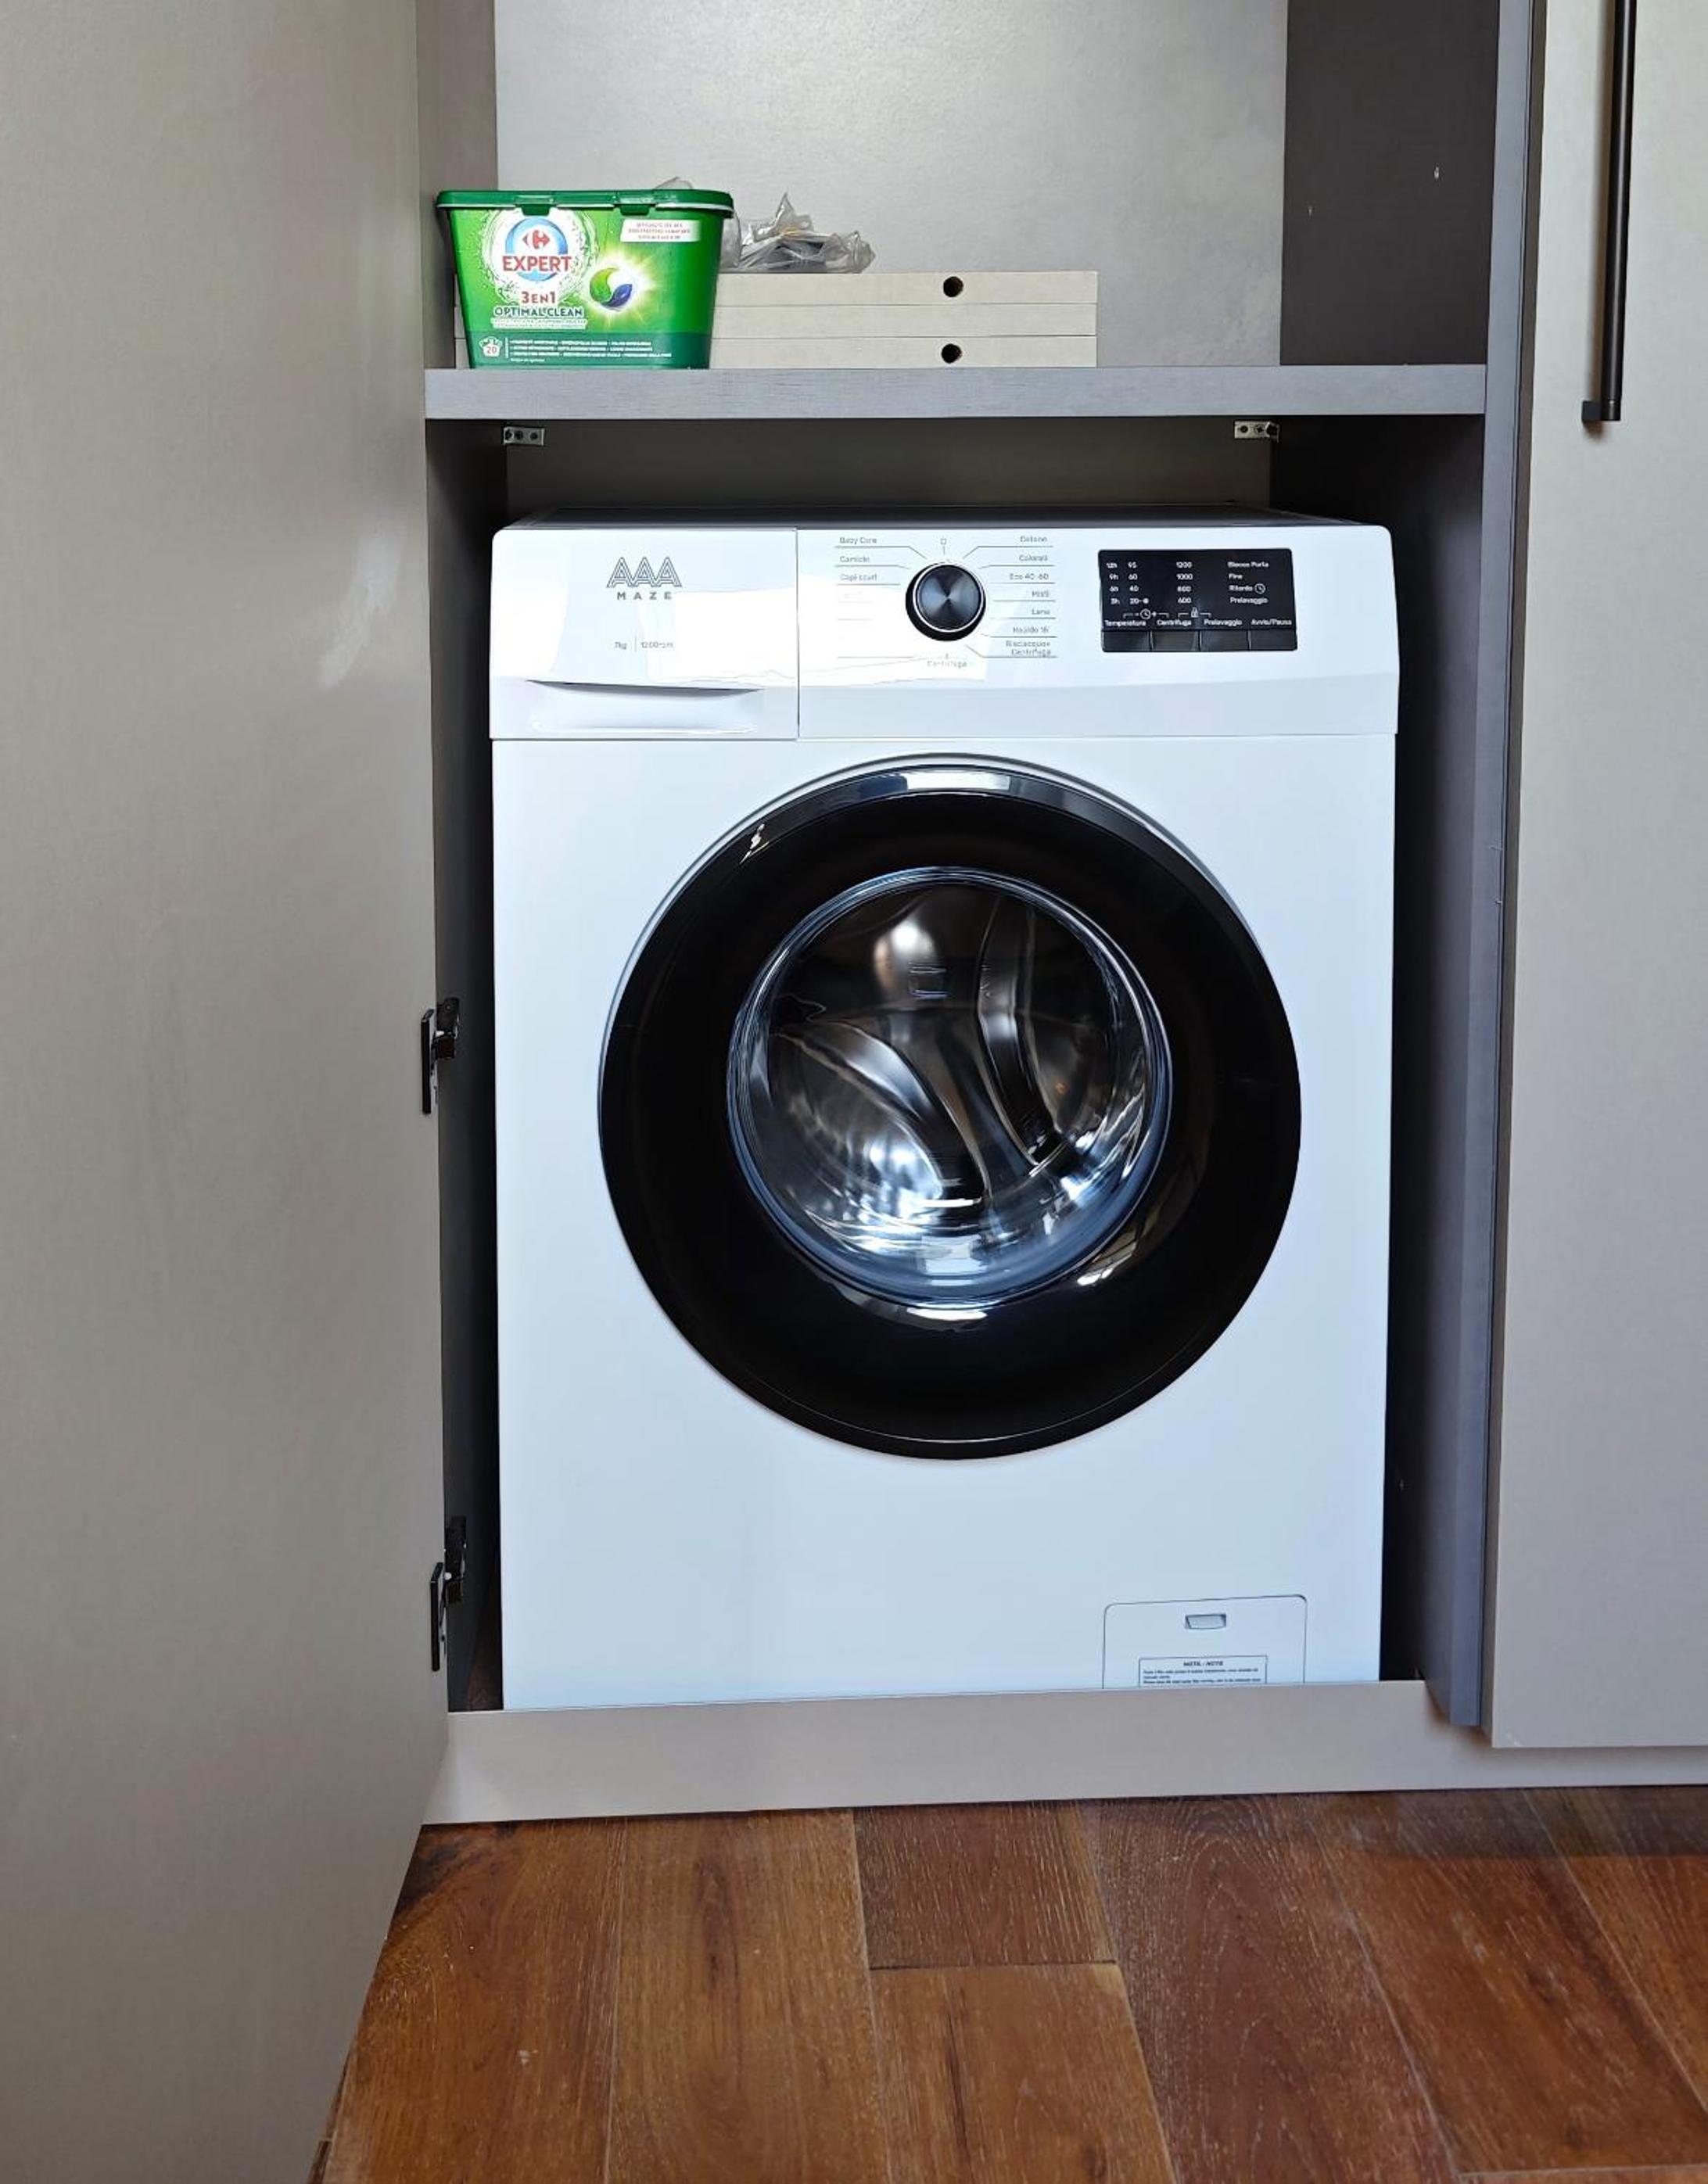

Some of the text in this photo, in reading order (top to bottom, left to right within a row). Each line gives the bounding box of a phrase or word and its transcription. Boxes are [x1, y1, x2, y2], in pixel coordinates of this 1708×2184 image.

[502, 256, 572, 272] EXPERT
[494, 307, 583, 317] OPTIMAL CLEAN
[486, 346, 497, 354] 20
[617, 591, 673, 601] MAZE
[1229, 597, 1268, 605] Prelavaggio
